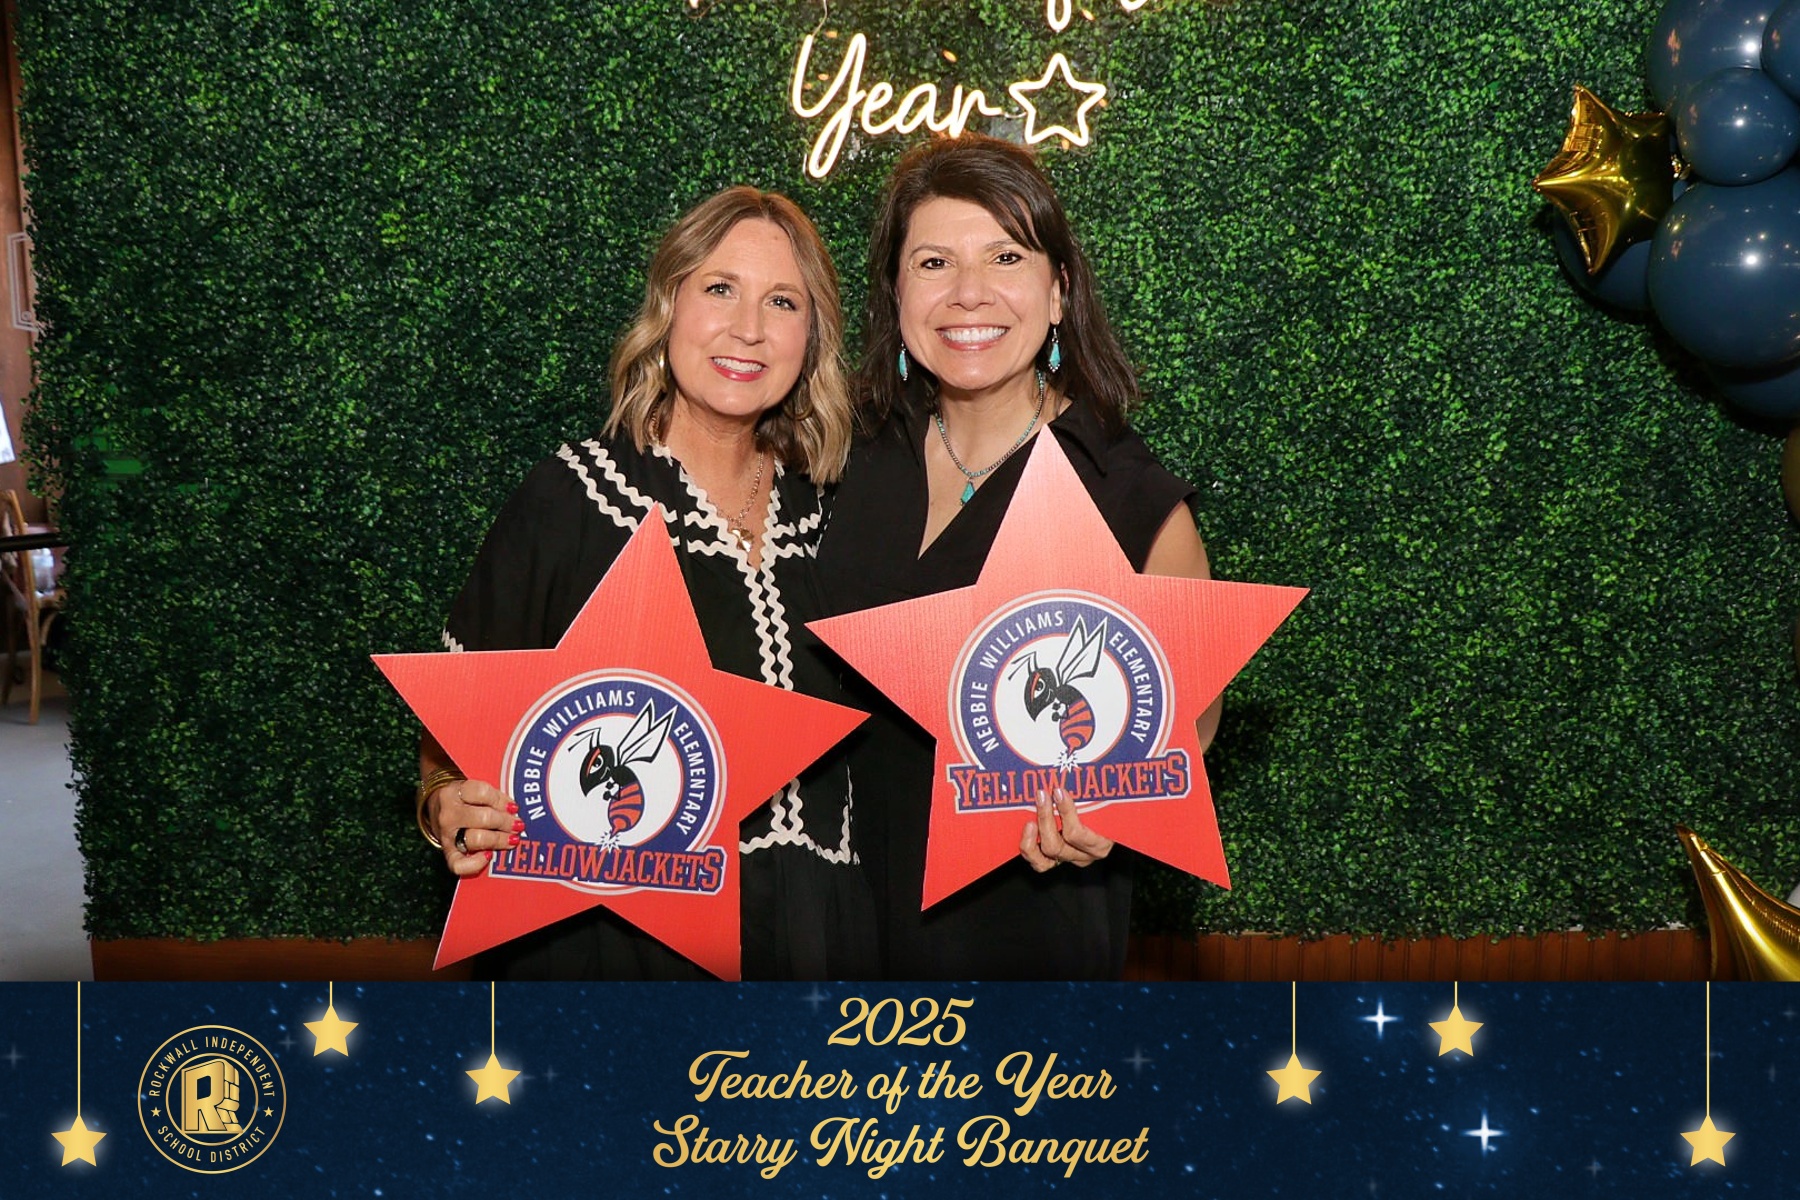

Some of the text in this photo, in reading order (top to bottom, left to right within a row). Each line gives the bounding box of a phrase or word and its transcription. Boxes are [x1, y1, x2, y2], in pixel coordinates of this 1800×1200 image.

[791, 33, 1002, 178] Year
[971, 610, 1153, 752] NEBBIE WILLIAMS ELEMENTARY
[523, 689, 706, 835] NEBBIE WILLIAMS ELEMENTARY
